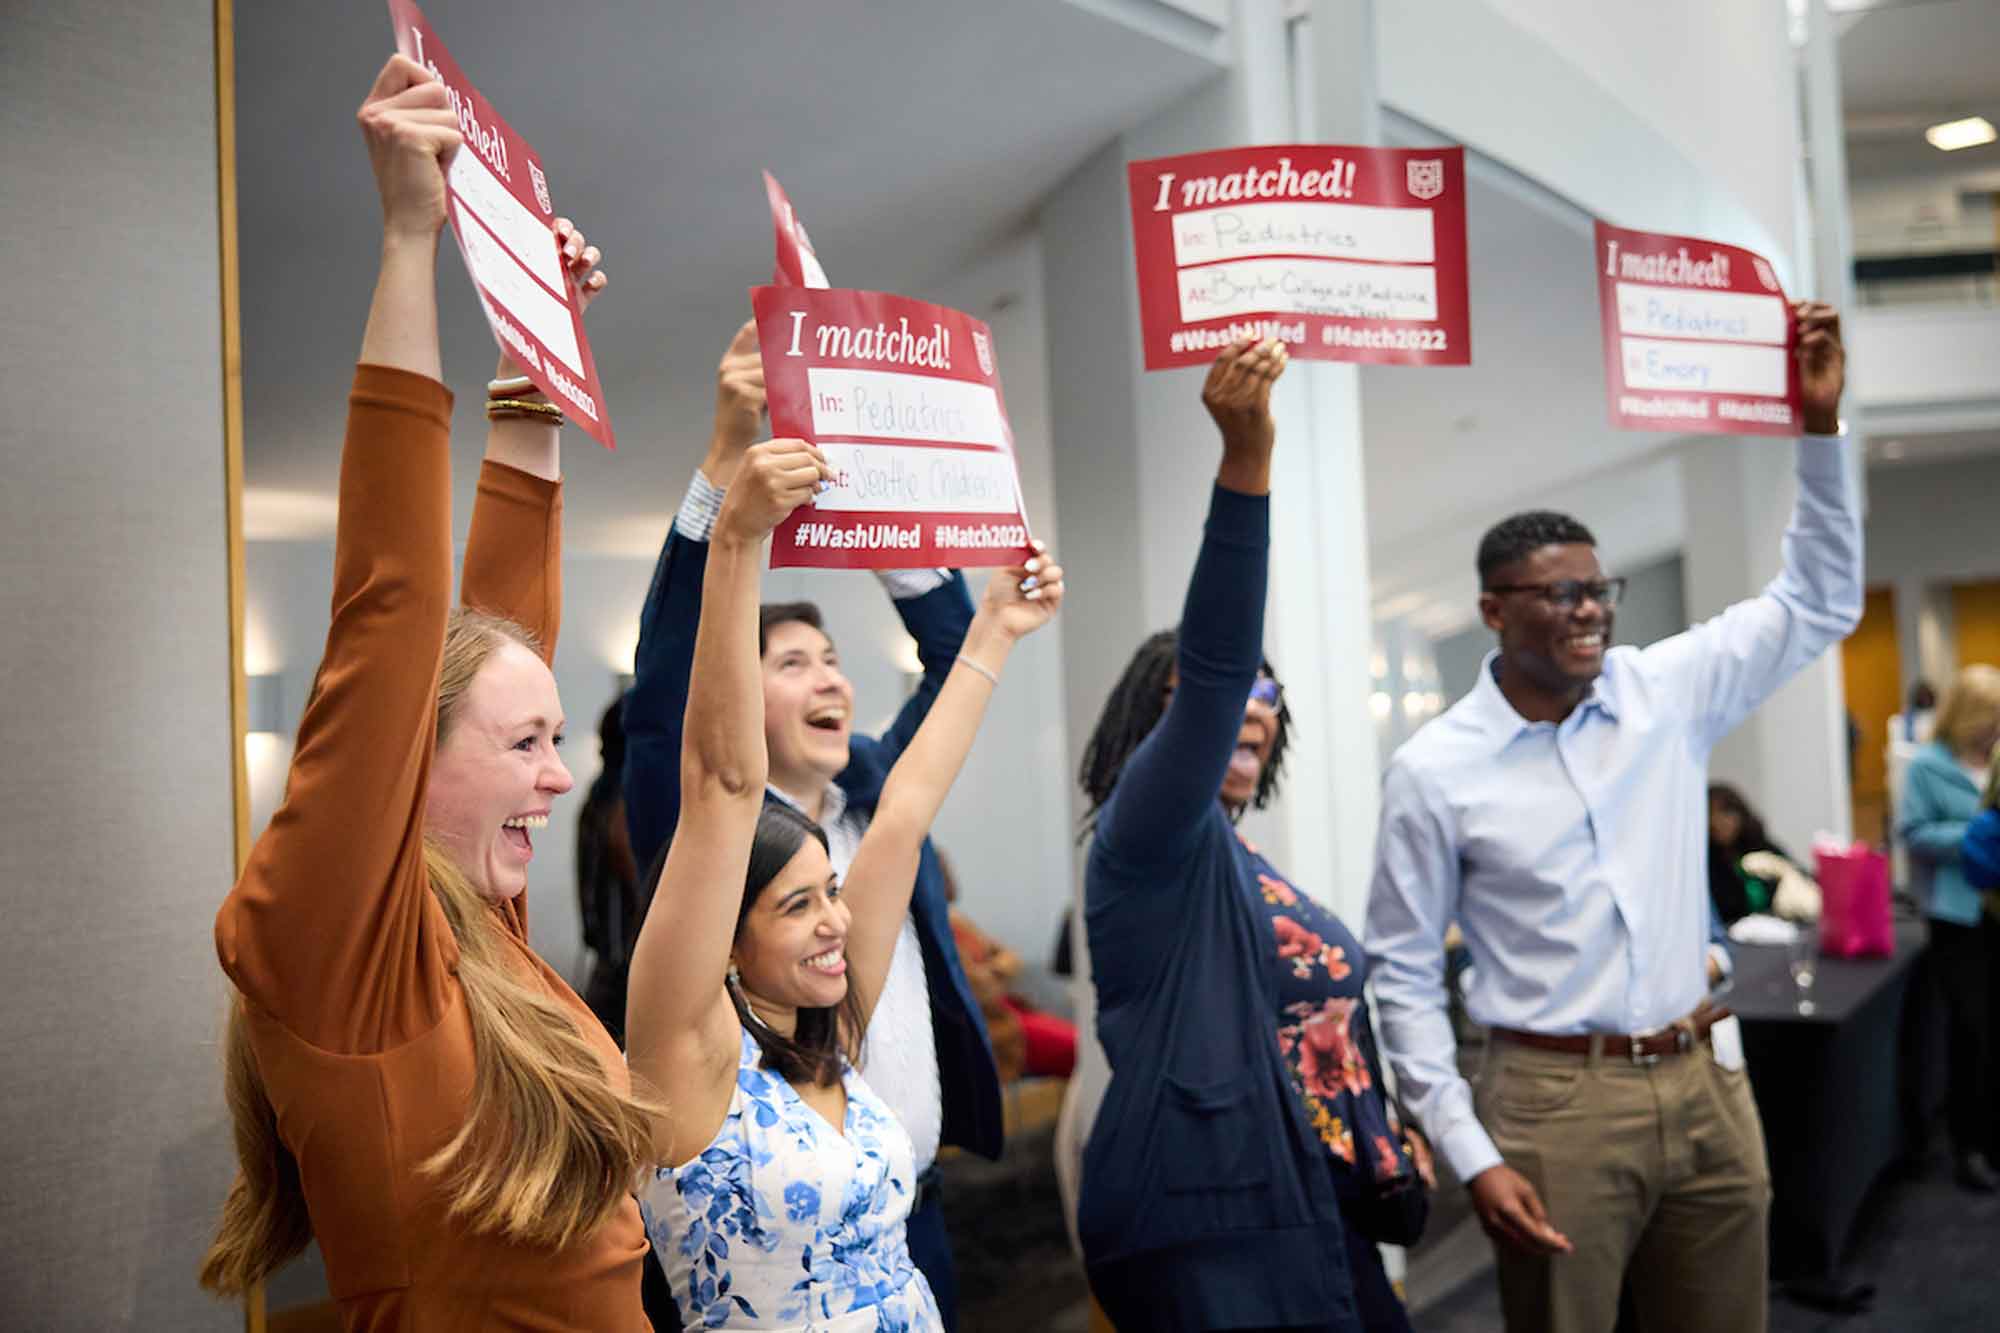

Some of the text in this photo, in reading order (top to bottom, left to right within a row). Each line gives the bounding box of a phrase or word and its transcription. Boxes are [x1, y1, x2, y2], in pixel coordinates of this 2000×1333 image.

[1153, 157, 1357, 212] I matched!
[1606, 239, 1732, 289] I matched!
[784, 311, 951, 370] I matched!
[1321, 325, 1448, 351] #Match2022
[819, 392, 845, 413] In:
[794, 523, 1026, 549] #WashUMed #Match2022
